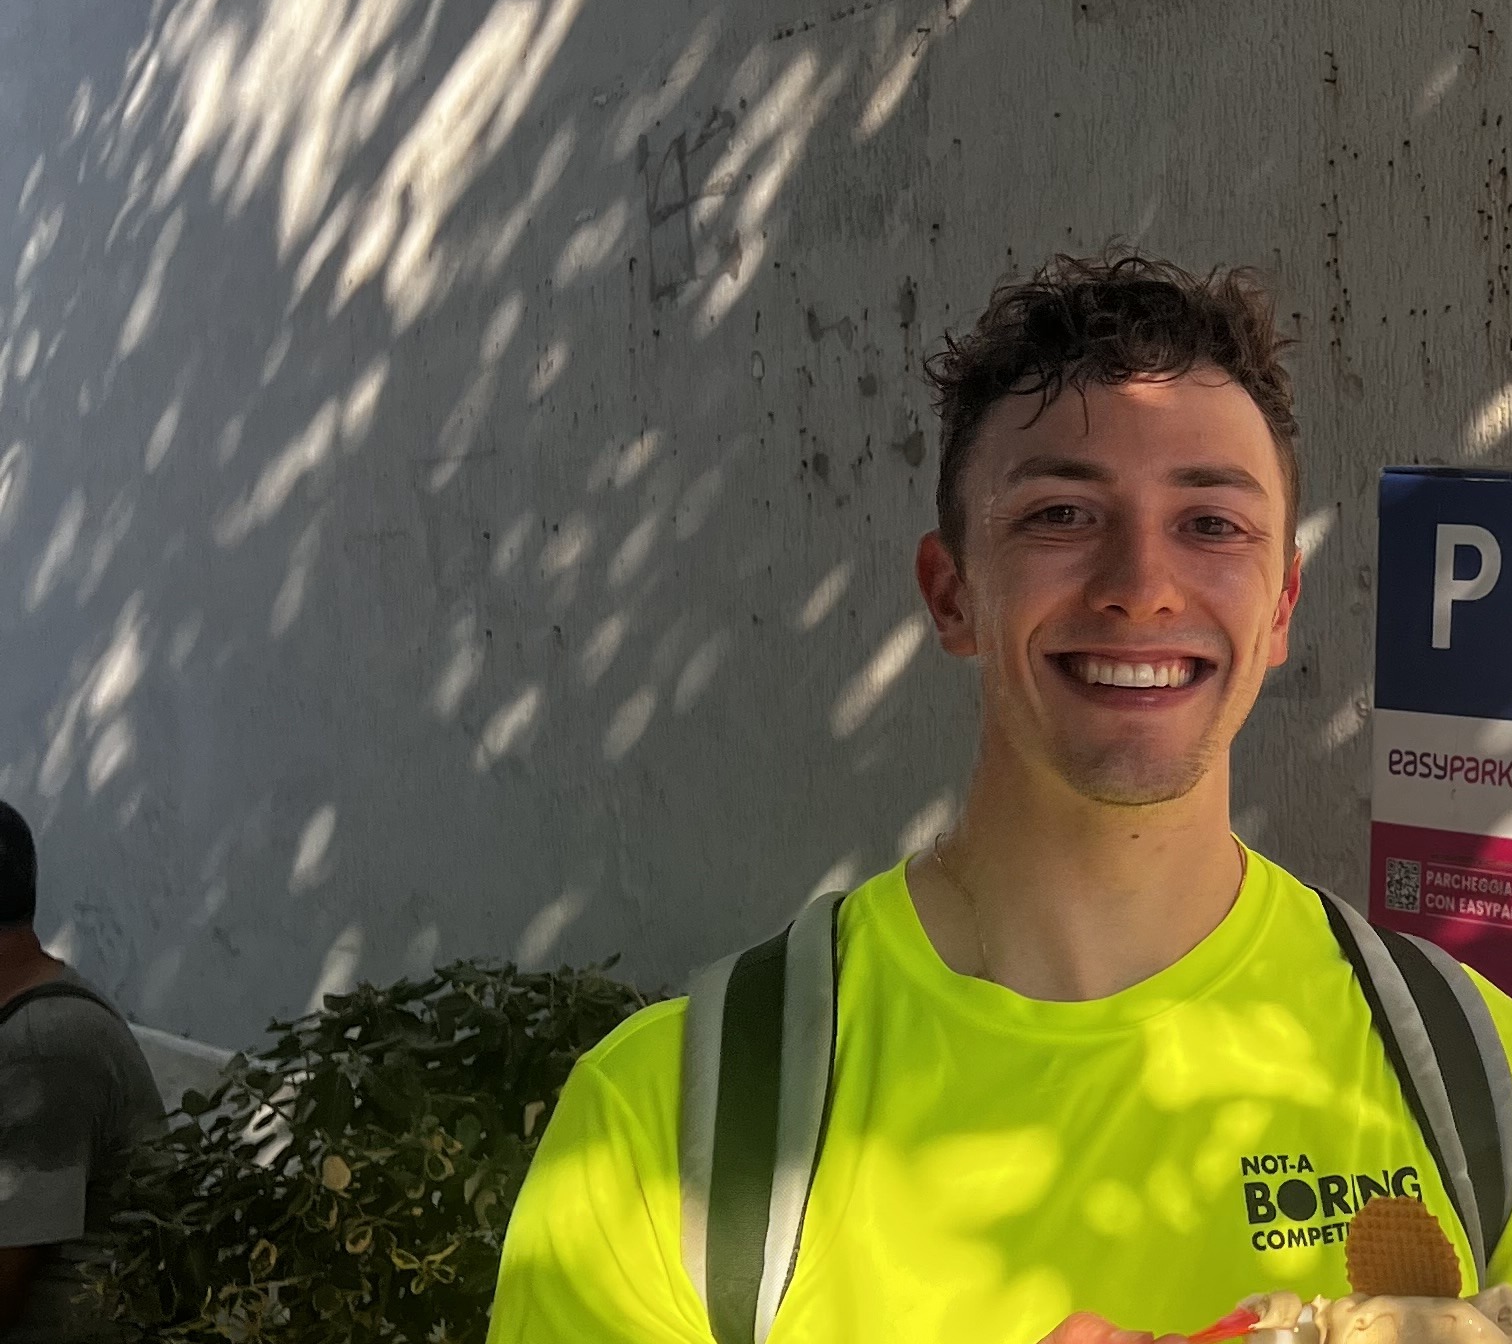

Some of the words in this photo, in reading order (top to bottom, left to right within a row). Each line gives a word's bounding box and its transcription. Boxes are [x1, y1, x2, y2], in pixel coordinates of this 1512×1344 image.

[1432, 523, 1502, 649] P
[1426, 870, 1512, 897] PARCHEGGIA
[1425, 893, 1456, 910] CON
[1241, 1154, 1314, 1176] NOT-A
